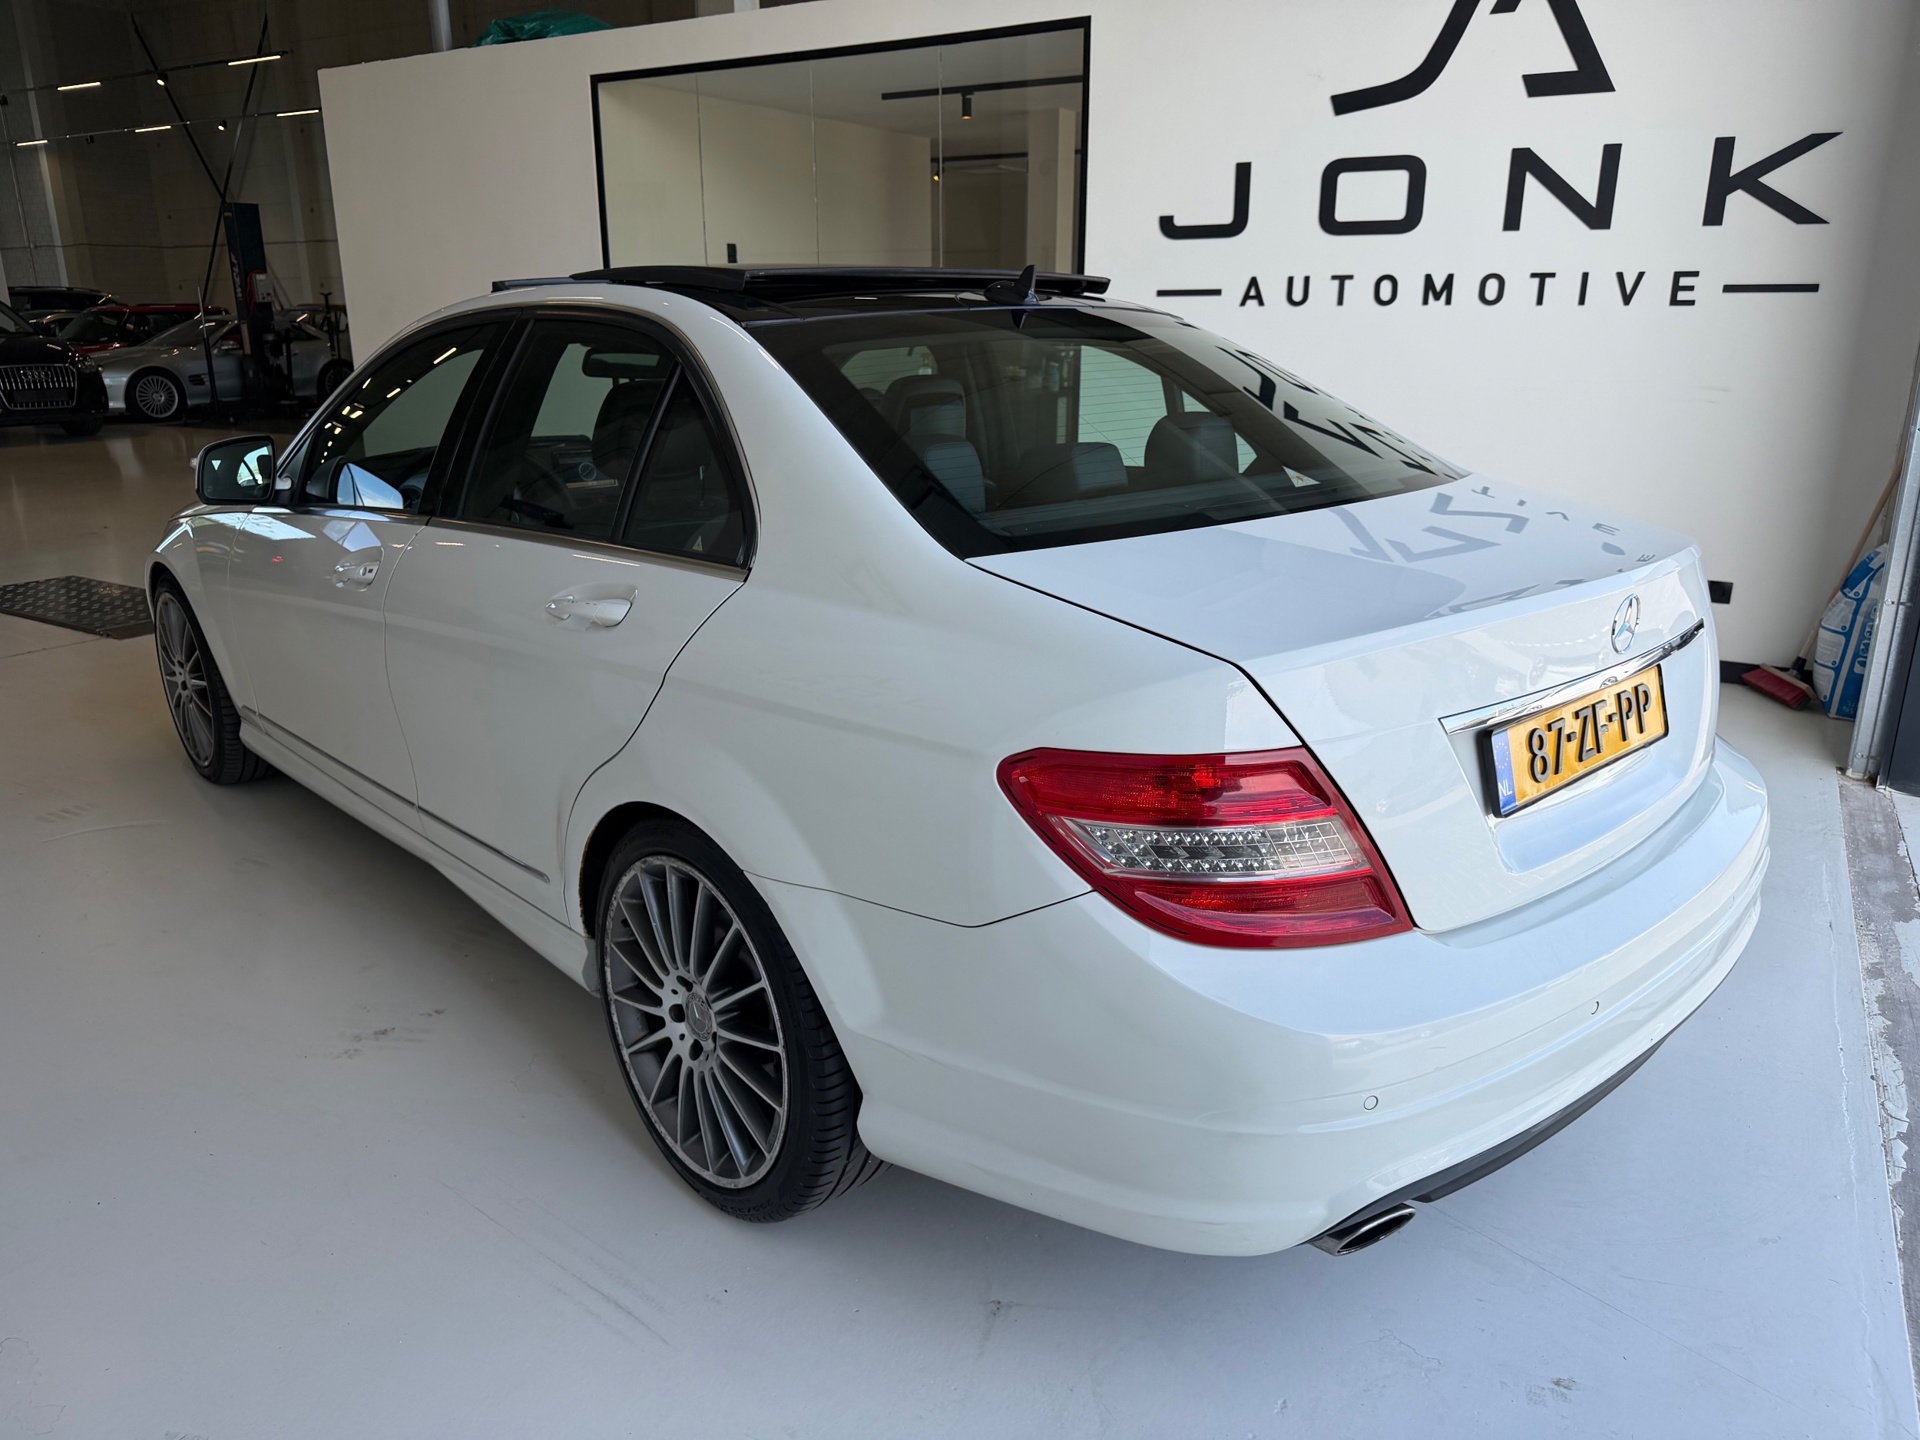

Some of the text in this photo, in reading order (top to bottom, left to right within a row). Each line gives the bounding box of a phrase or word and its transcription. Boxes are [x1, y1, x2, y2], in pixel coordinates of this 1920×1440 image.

[1159, 132, 1843, 240] JONK
[1239, 270, 1700, 307] AUTOMOTIVE
[1529, 683, 1651, 783] 87-ZF-PP
[1498, 781, 1513, 798] NL
